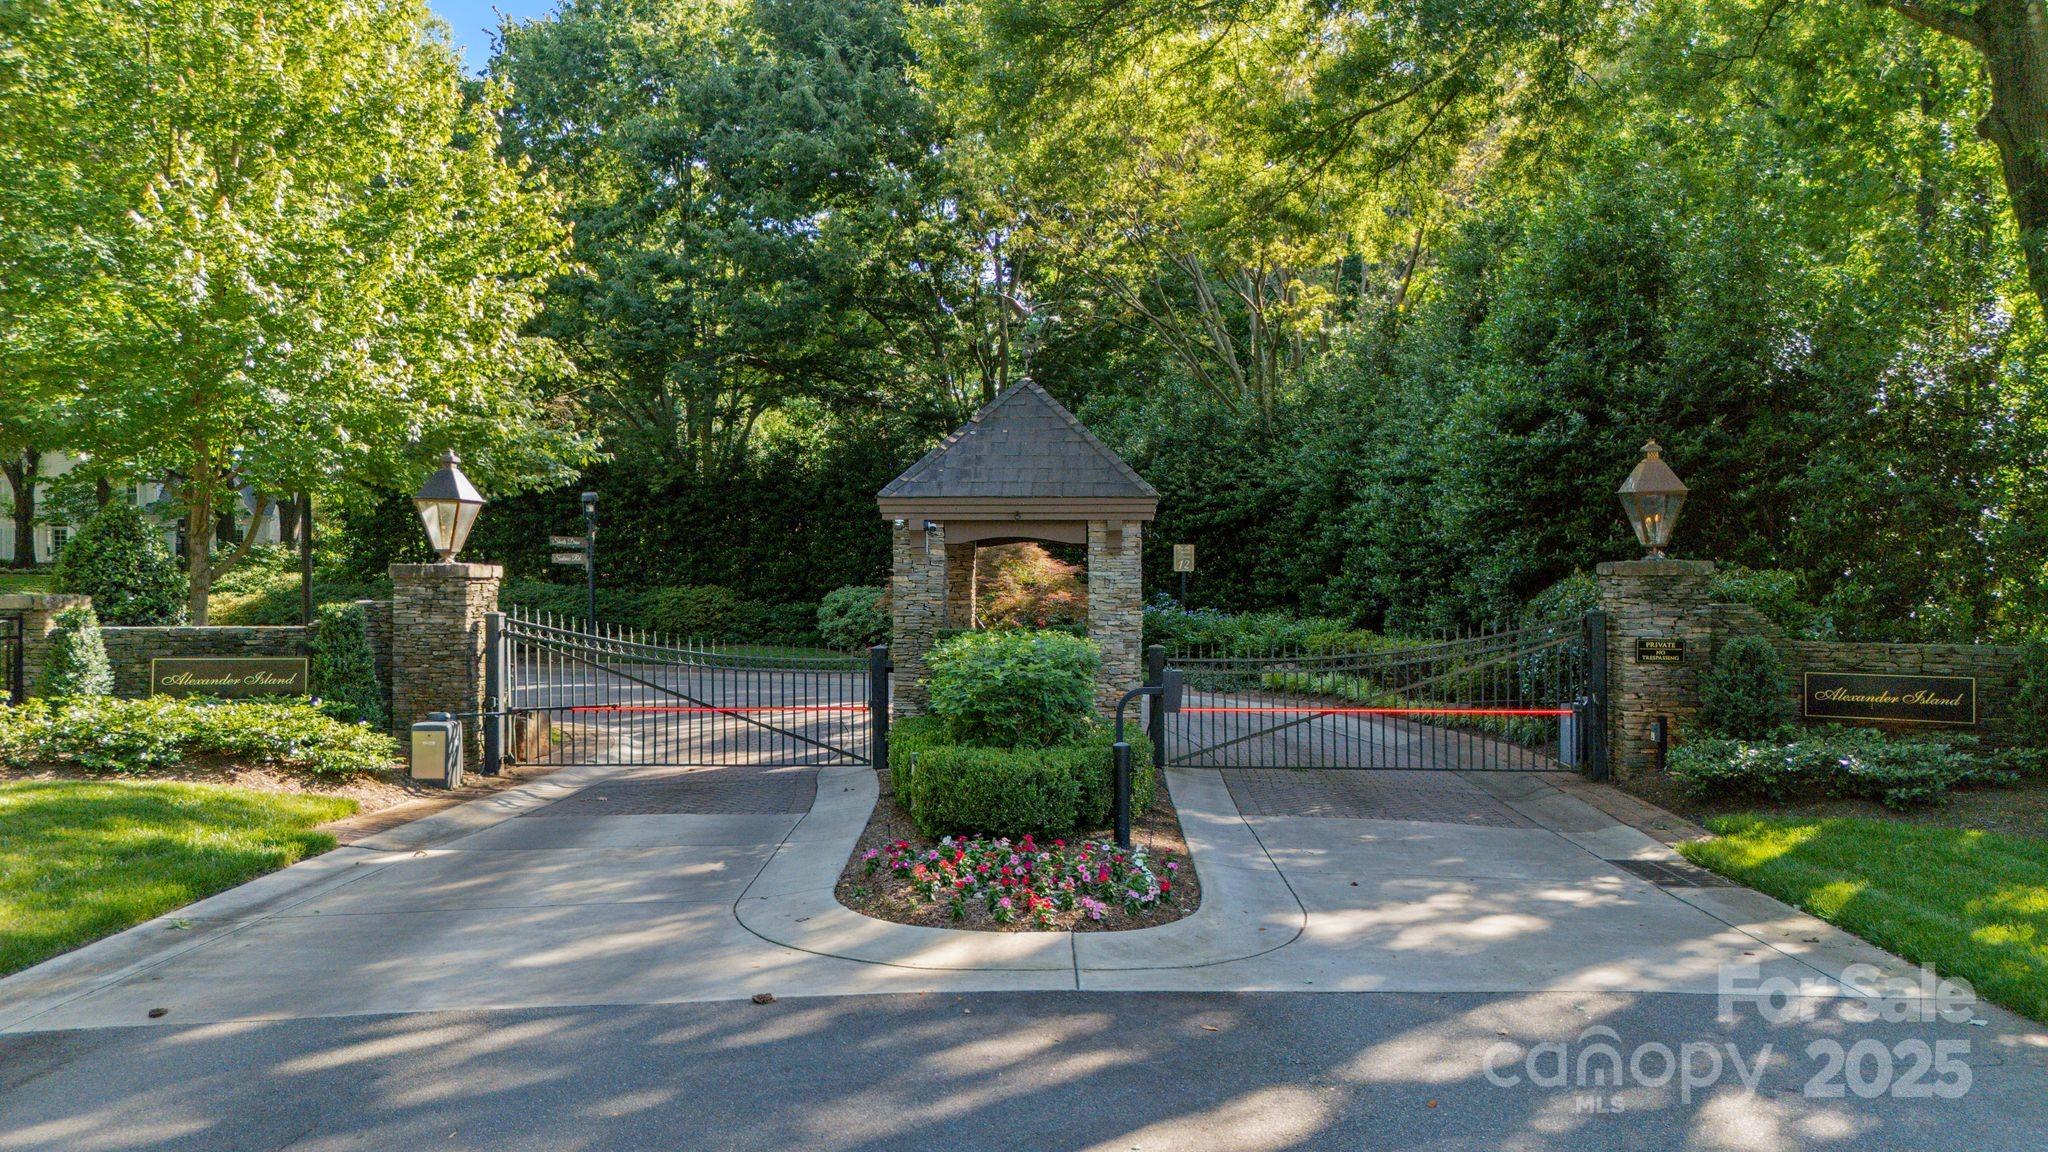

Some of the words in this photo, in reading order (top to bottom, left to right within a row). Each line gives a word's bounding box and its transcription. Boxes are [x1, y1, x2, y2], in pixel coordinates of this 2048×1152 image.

[1178, 559, 1190, 570] 12
[161, 671, 241, 686] Alexander
[243, 670, 298, 685] Island
[1814, 687, 1899, 703] Alexander
[1902, 690, 1964, 706] Island
